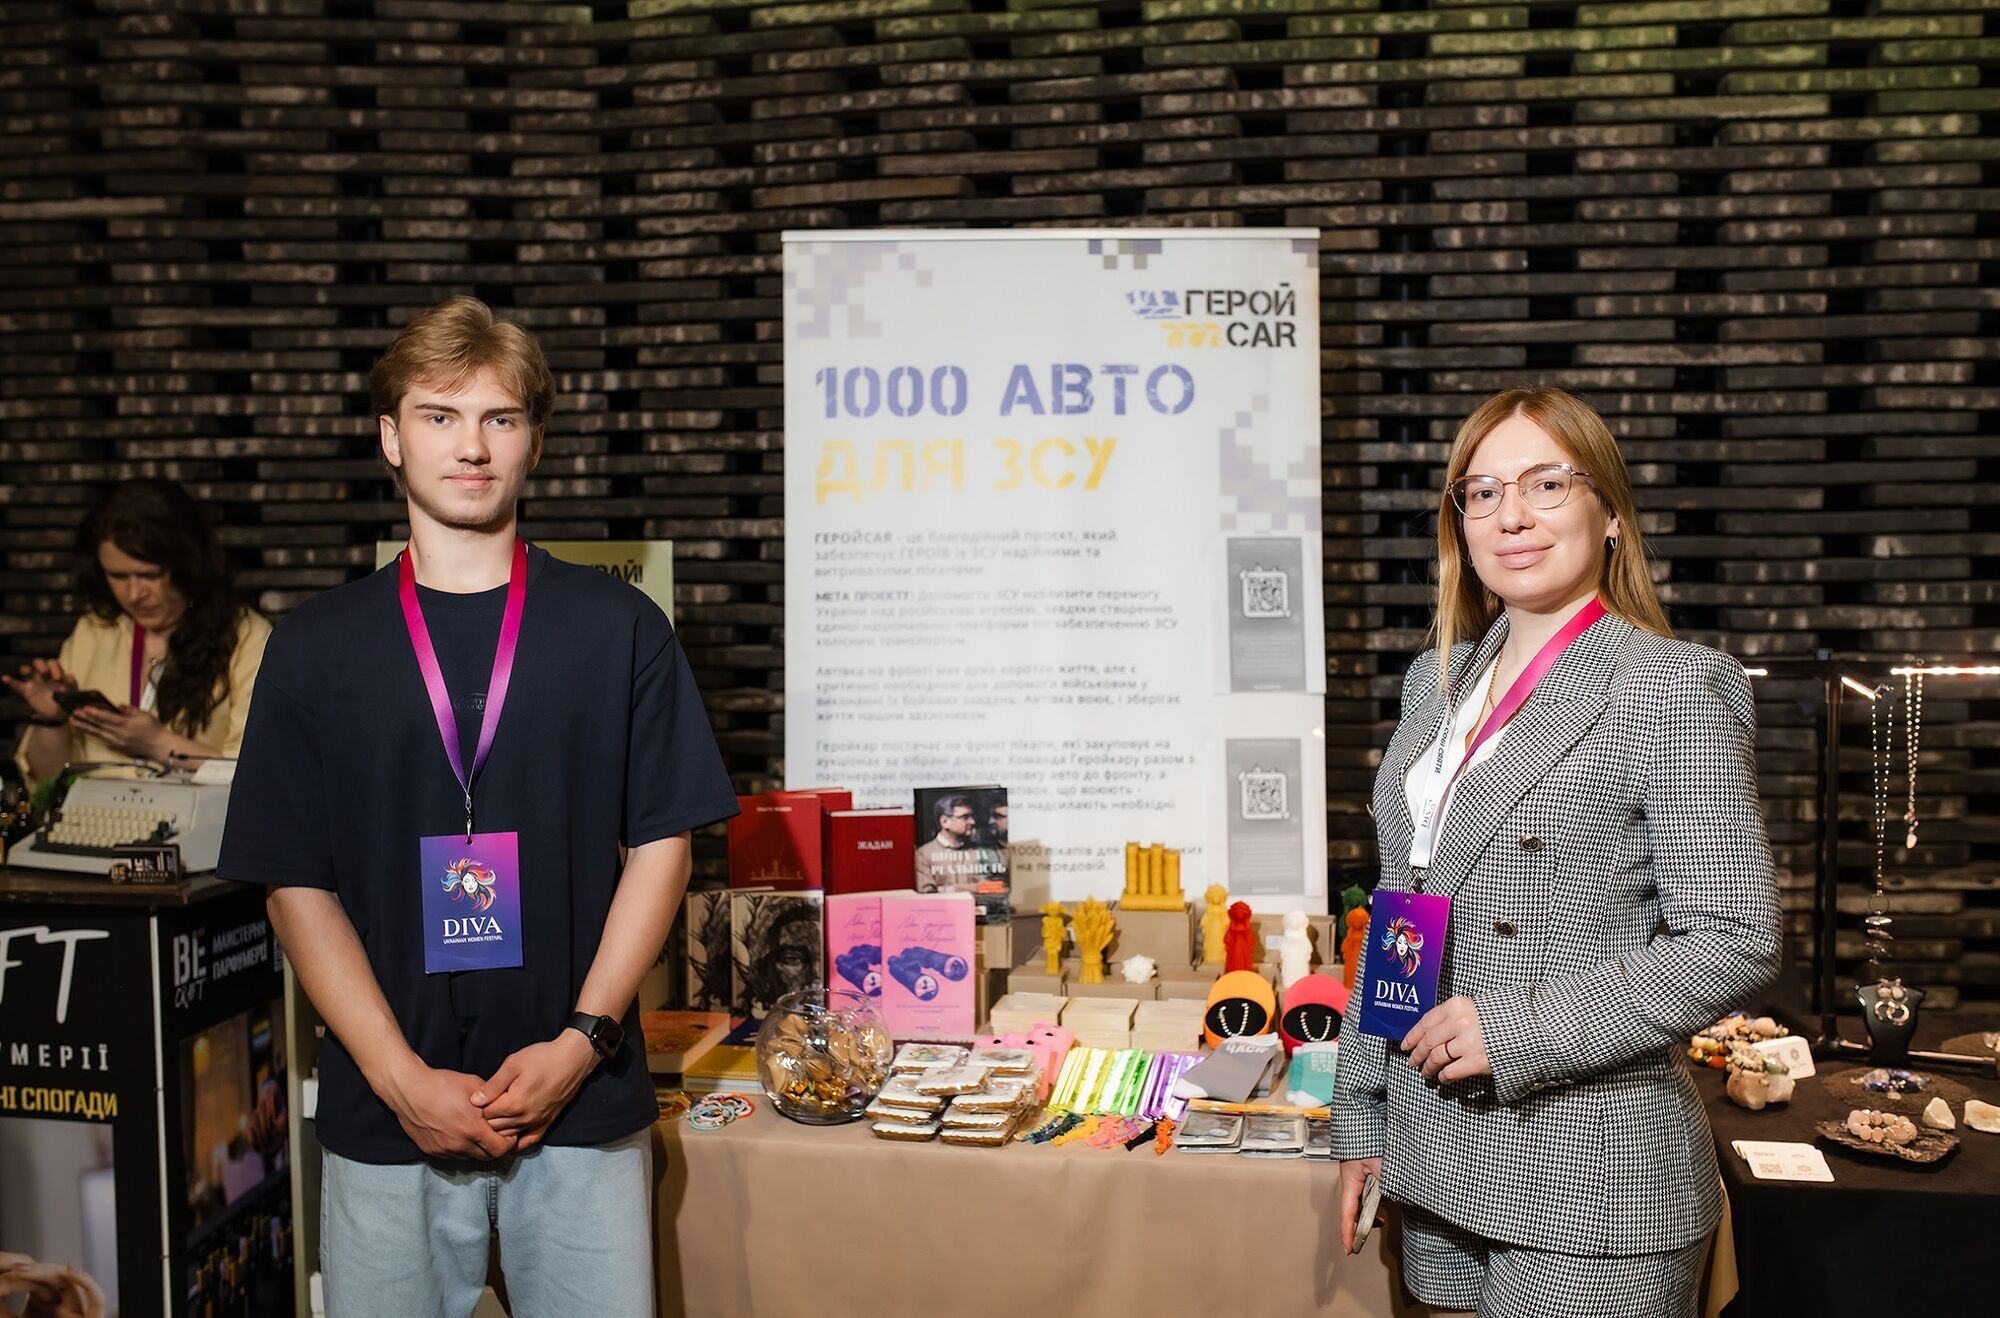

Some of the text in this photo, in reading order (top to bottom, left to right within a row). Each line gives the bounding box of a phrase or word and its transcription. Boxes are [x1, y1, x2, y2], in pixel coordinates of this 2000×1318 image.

[1185, 282, 1295, 316] ГЕРОЙ
[1226, 321, 1296, 348] CAR
[815, 363, 1195, 418] 1000 АВТО
[815, 436, 1118, 506] ДЛЯ ЗСУ
[857, 839, 894, 851] ЖАДАН
[443, 915, 503, 938] DIVA
[443, 934, 503, 945] UKRAINIAN WOMEN FESTIVAL
[1375, 979, 1420, 1005] DIVA
[1374, 1000, 1391, 1008] UKRAINIAN
[1404, 1005, 1419, 1013] FESTIVAL
[0, 1041, 109, 1071] МЕРІЇ
[21, 1086, 118, 1121] СПОГАДИ
